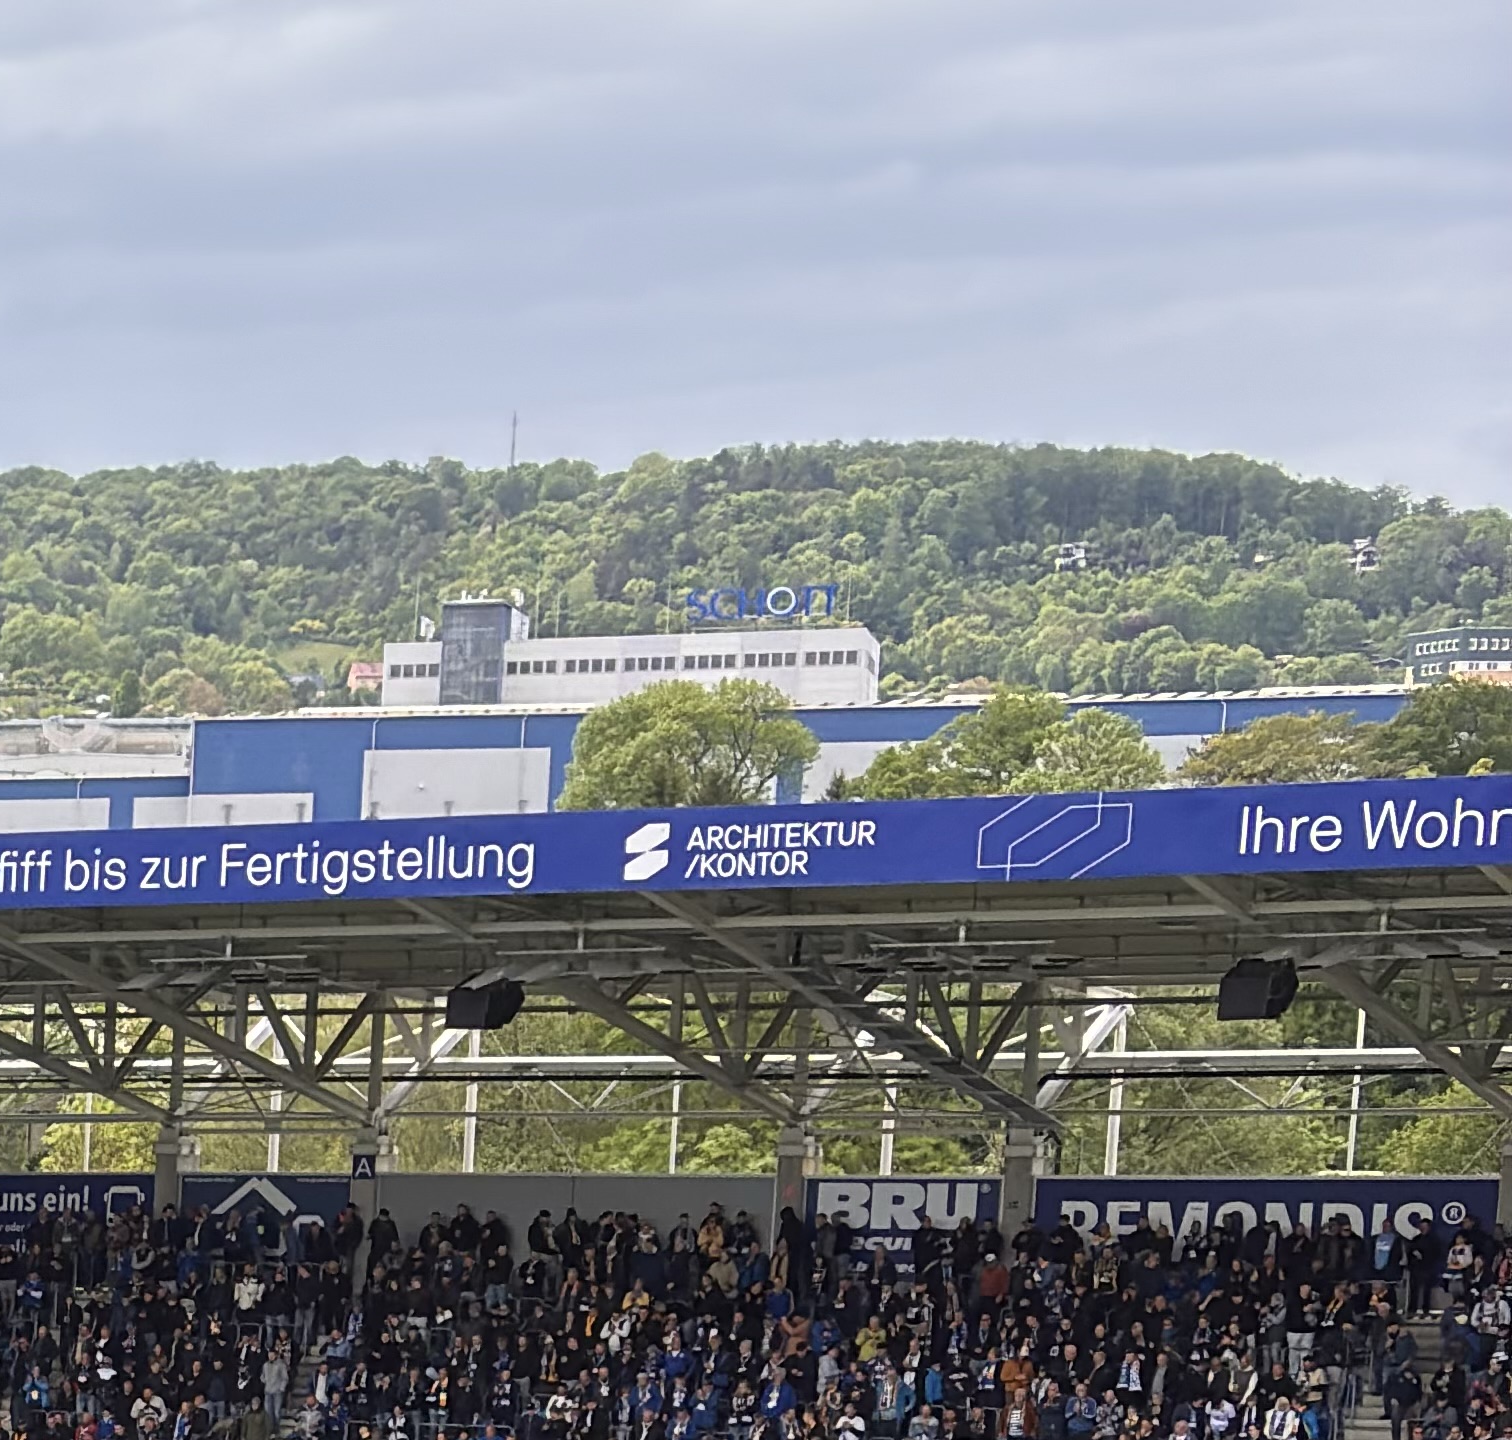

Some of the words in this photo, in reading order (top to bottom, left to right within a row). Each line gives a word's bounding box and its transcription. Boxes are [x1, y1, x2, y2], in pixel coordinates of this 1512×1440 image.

[686, 583, 838, 623] SCHOTT
[686, 820, 876, 851] ARCHITEKTUR
[1239, 802, 1343, 855] Ihre
[63, 847, 124, 892] bis
[139, 850, 208, 890] zur
[220, 826, 535, 897] Fertigstellung
[43, 1185, 90, 1212] ein!
